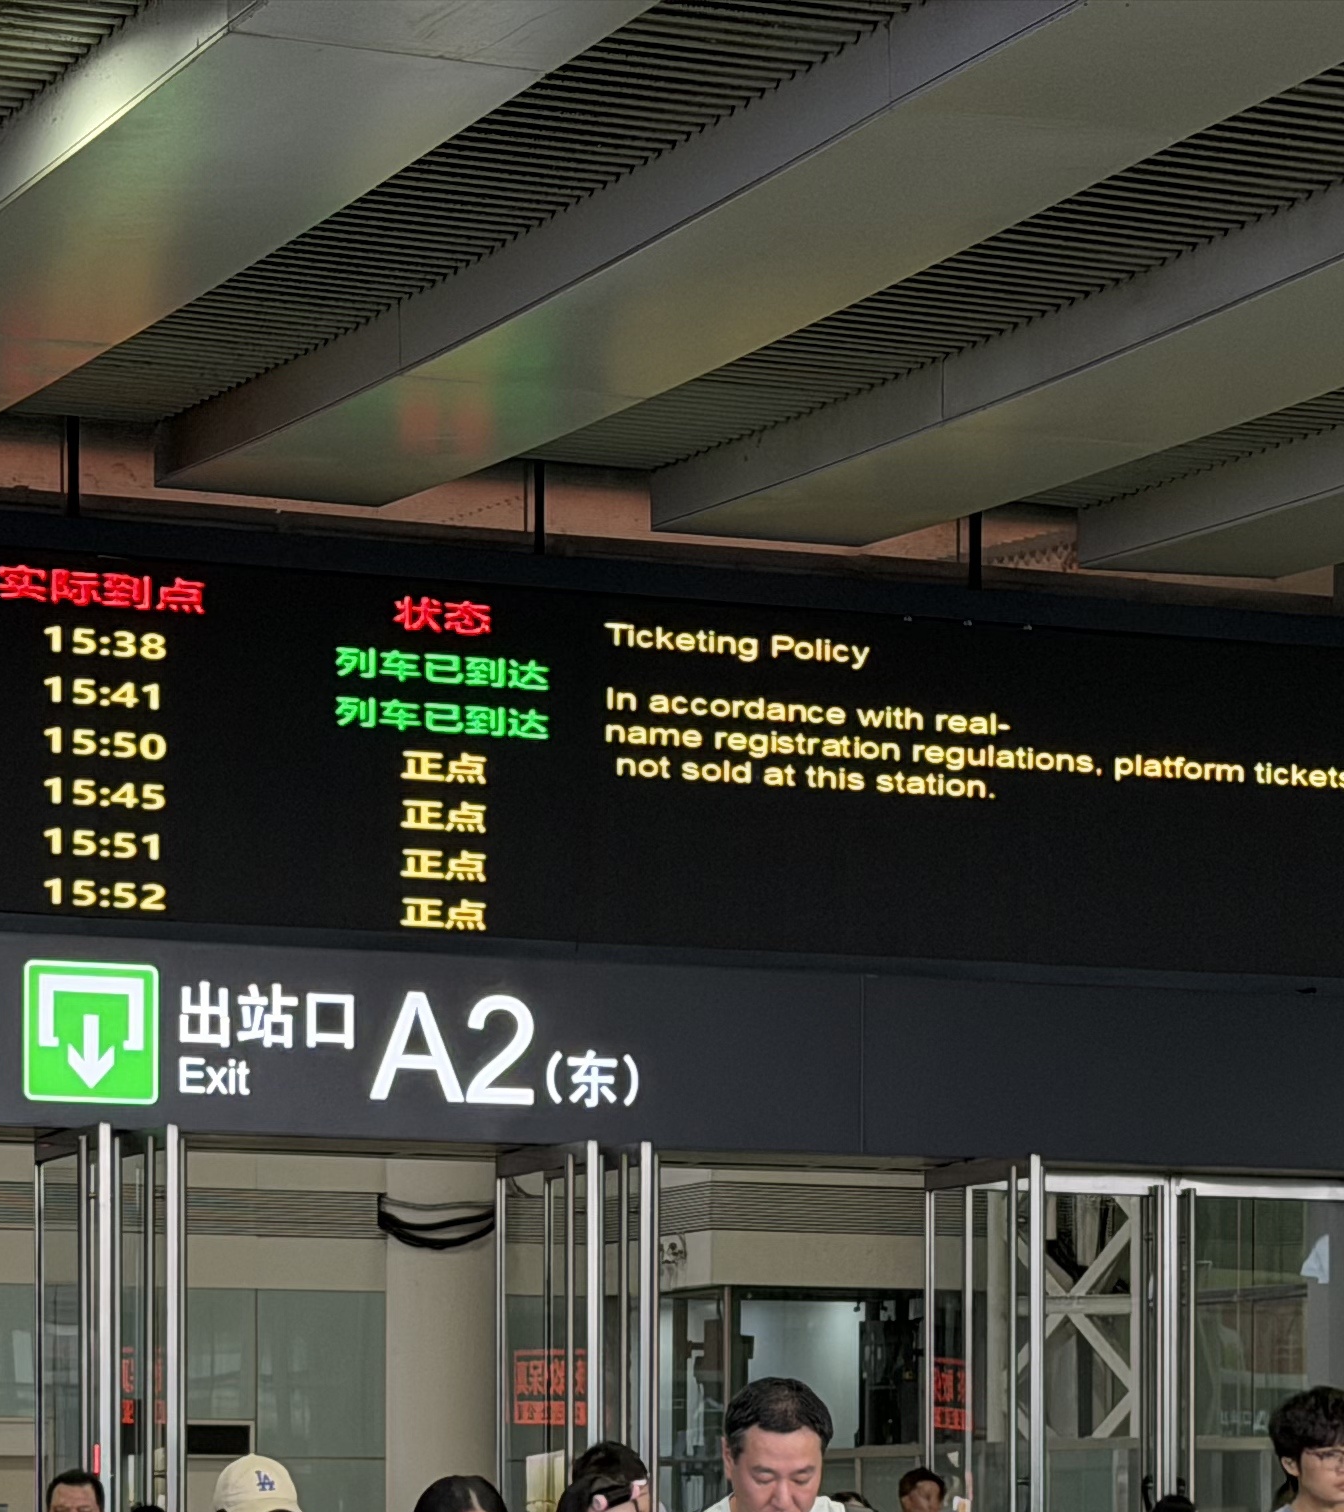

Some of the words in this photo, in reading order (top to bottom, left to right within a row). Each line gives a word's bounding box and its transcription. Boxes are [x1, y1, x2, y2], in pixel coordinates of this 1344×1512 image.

[394, 596, 491, 636] 状态
[44, 626, 166, 659] 15:38
[336, 647, 549, 690] 列车已到达
[605, 623, 758, 662] Ticketing
[772, 635, 869, 669] Policy
[44, 676, 159, 710] 15:41
[335, 697, 548, 739] 列车已到达
[607, 687, 636, 711] In
[649, 695, 846, 724] accordance
[857, 706, 923, 730] with
[936, 713, 1010, 735] real-
[44, 727, 166, 760] 15:50
[401, 751, 487, 784] 正点
[606, 724, 702, 747] name
[715, 731, 900, 761] registration
[913, 745, 1102, 776] regulations,
[1115, 754, 1244, 782] platform
[617, 756, 670, 778] not
[682, 760, 751, 783] sold
[764, 764, 795, 786] at
[805, 766, 865, 790] this
[876, 771, 995, 798] station.
[44, 777, 165, 810] 15:45
[401, 800, 486, 833] 正点
[44, 828, 159, 860] 15:51
[400, 849, 486, 882] 正点
[44, 878, 166, 910] 15:52
[400, 898, 486, 930] 正点
[179, 981, 354, 1049] 出站口
[179, 1056, 250, 1095] Exit
[370, 991, 534, 1105] A2
[546, 1050, 638, 1107] (东)
